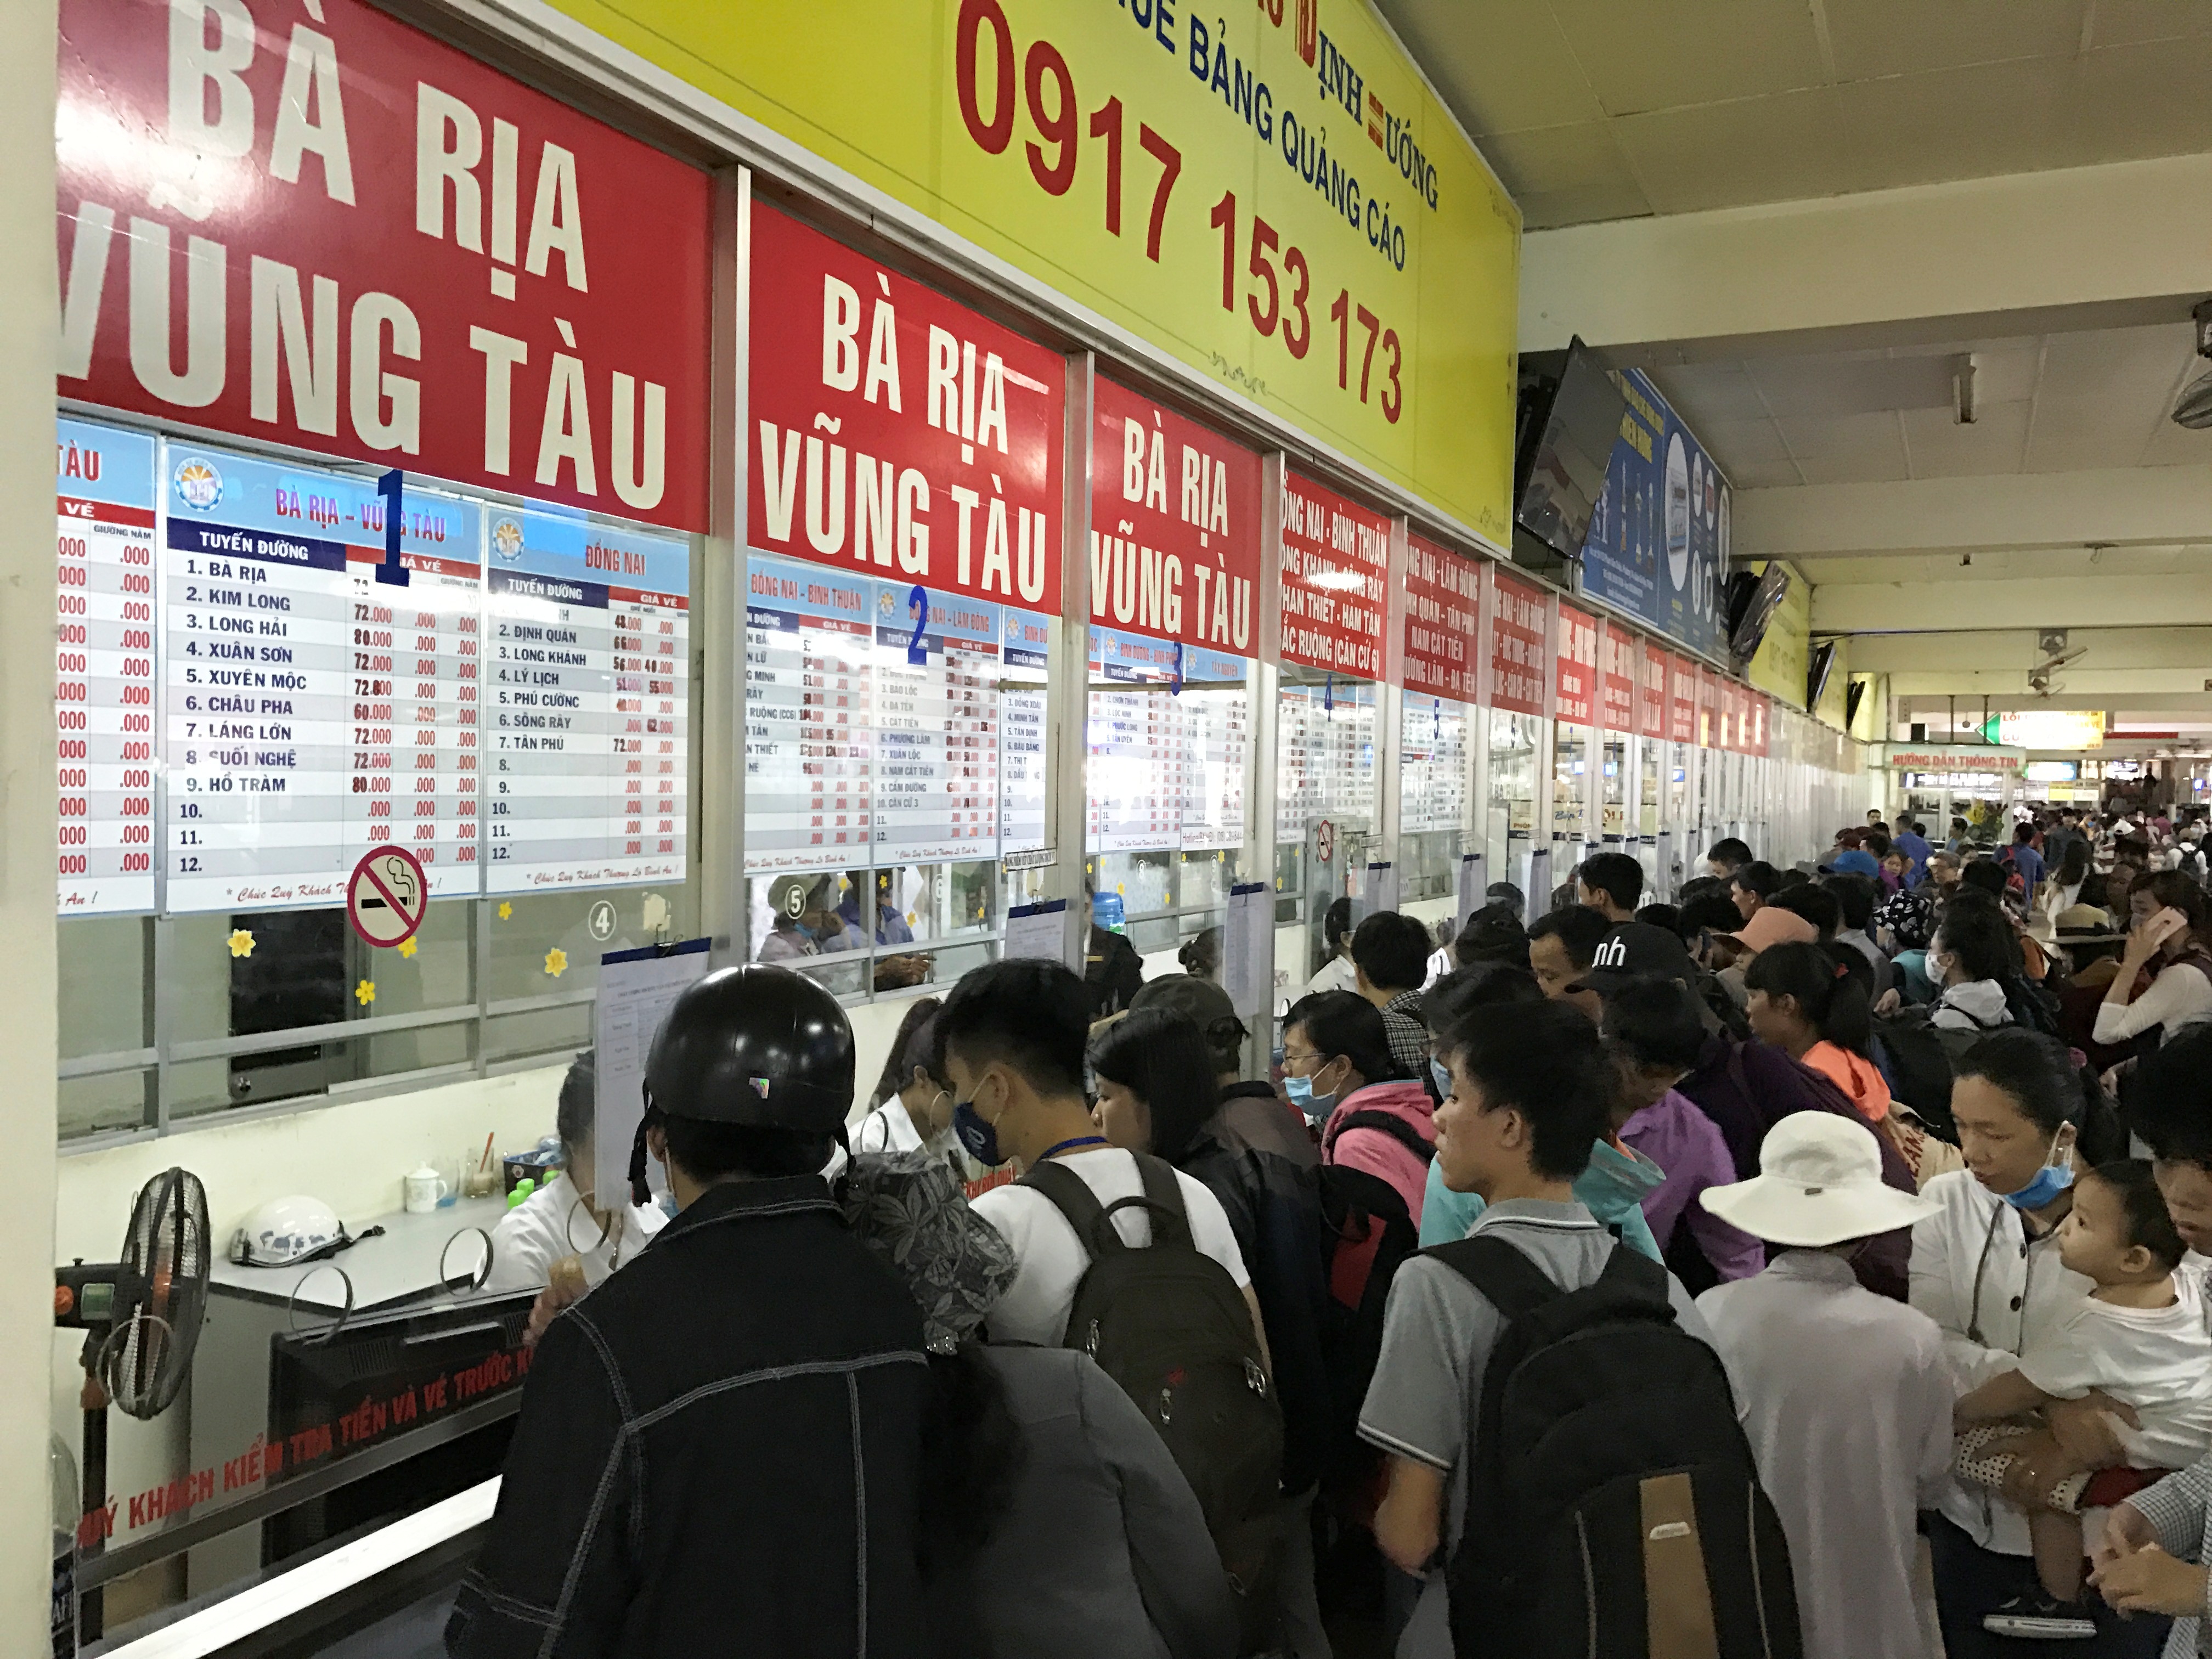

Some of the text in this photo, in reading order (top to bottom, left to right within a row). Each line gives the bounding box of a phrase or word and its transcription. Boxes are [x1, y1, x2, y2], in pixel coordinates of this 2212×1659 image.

[168, 0, 589, 301] BÀ RỊA
[1189, 17, 1273, 146] BẢNG
[1282, 111, 1361, 228] QUẢNG
[1367, 198, 1406, 272] CÁO
[956, 0, 1181, 263] 0917
[1211, 190, 1311, 359] 153
[1331, 288, 1402, 425] 173
[822, 270, 1008, 466] BÀ RỊA
[470, 317, 667, 510] TÀU
[1123, 409, 1228, 548] BÀ RỊA
[276, 485, 445, 543] BÀ RỊA VŨG TÀU
[759, 412, 1046, 603] VŨNG TÀU
[376, 469, 409, 587] 1
[1306, 499, 1324, 544] NAI
[1332, 503, 1356, 556] BÌNH
[200, 530, 309, 561] TUYẾN ĐƯỜNG
[585, 538, 646, 576] ĐỒNG NAI
[400, 557, 417, 569] IÁ
[1281, 542, 1300, 575] ONG
[187, 560, 267, 584] 1. BÀ RỊA
[508, 578, 544, 596] TUYẾN
[1091, 520, 1251, 650] VŨNG TÀU
[187, 587, 291, 612] 2. KIM LONG
[1282, 584, 1304, 616] HAN
[1364, 606, 1380, 637] TÂN
[187, 614, 287, 637] 3. LONG HẢI
[499, 625, 577, 643] 2. ĐỊNH QUÁN
[908, 585, 928, 666] 2
[187, 640, 292, 664] 4. XUÂN SƠN
[1282, 614, 1296, 653] ẮC
[1298, 627, 1332, 665] RUỘNG
[1334, 635, 1356, 669] (CĂN
[1412, 625, 1430, 652] NAM
[1431, 629, 1446, 657] CÁT
[499, 647, 586, 666] 3. LONG KHÁNH
[187, 666, 307, 691] 5. XUYÊN MỘC
[499, 670, 510, 682] 4.
[533, 671, 559, 687] LỊCH
[1427, 659, 1444, 687] LÂM
[186, 694, 293, 715] 6. CHÂU PHA
[499, 692, 510, 704] 5.
[514, 690, 538, 706] PHÚ
[187, 720, 291, 740] 7. LÁNG LỚN
[499, 714, 510, 727] 6.
[514, 712, 545, 728] SÔNG
[499, 734, 563, 751] 7. TÂN PHÚ
[255, 749, 297, 768] NGHỆ
[1959, 753, 1996, 767] THÔNG
[2000, 757, 2018, 767] TIN
[187, 770, 286, 793] 9. HỒ TRÀM
[180, 803, 202, 819] 10.
[180, 830, 202, 845] 11.
[180, 857, 202, 872] 12.
[492, 847, 510, 860] 12.
[788, 891, 802, 913] 5
[595, 906, 609, 934] 4
[129, 1468, 215, 1529] KHÁCH
[223, 1431, 283, 1492] KIỂM
